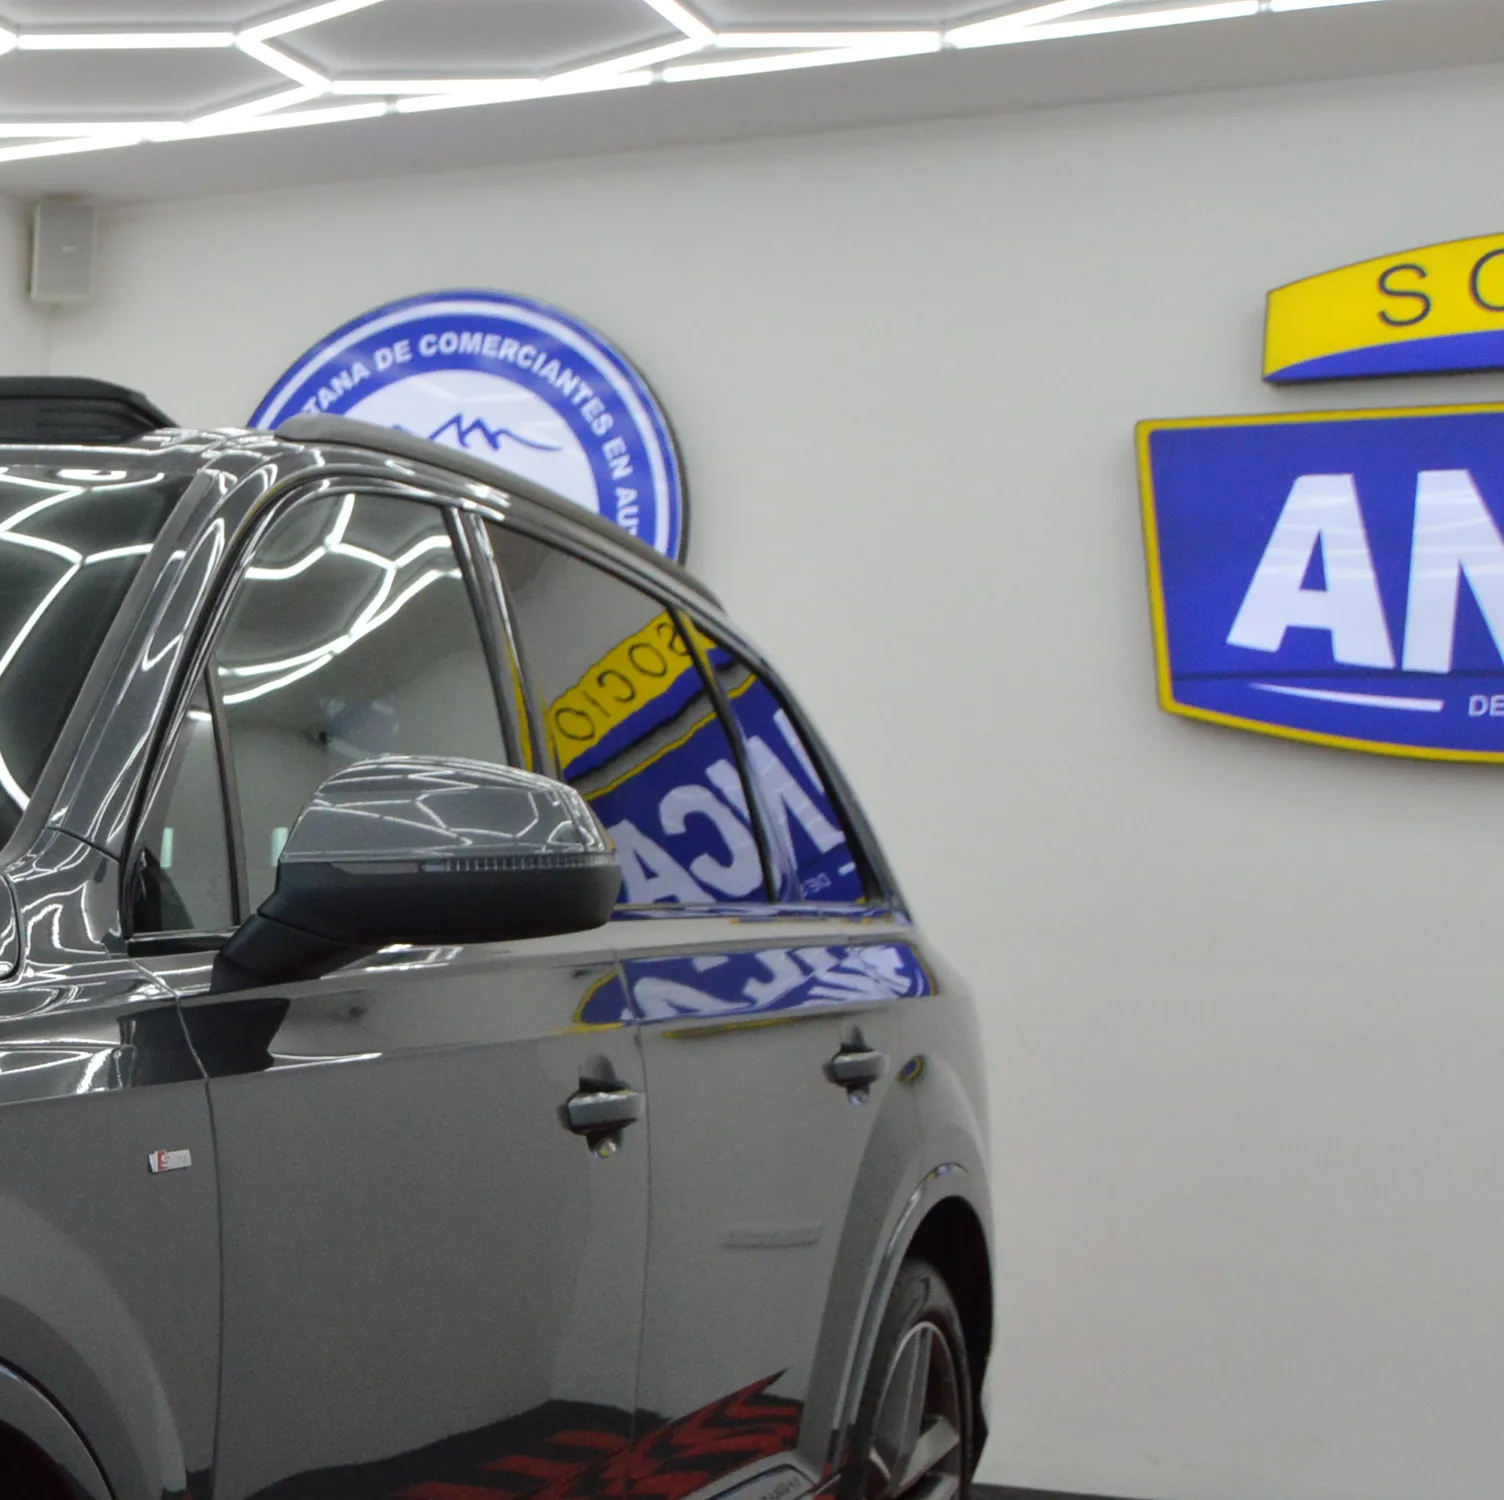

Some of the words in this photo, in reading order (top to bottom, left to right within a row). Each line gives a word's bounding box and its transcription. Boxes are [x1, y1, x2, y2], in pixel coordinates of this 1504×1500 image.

[374, 339, 413, 369] DE
[419, 331, 614, 436] COMERCIANTES
[601, 436, 634, 480] EN
